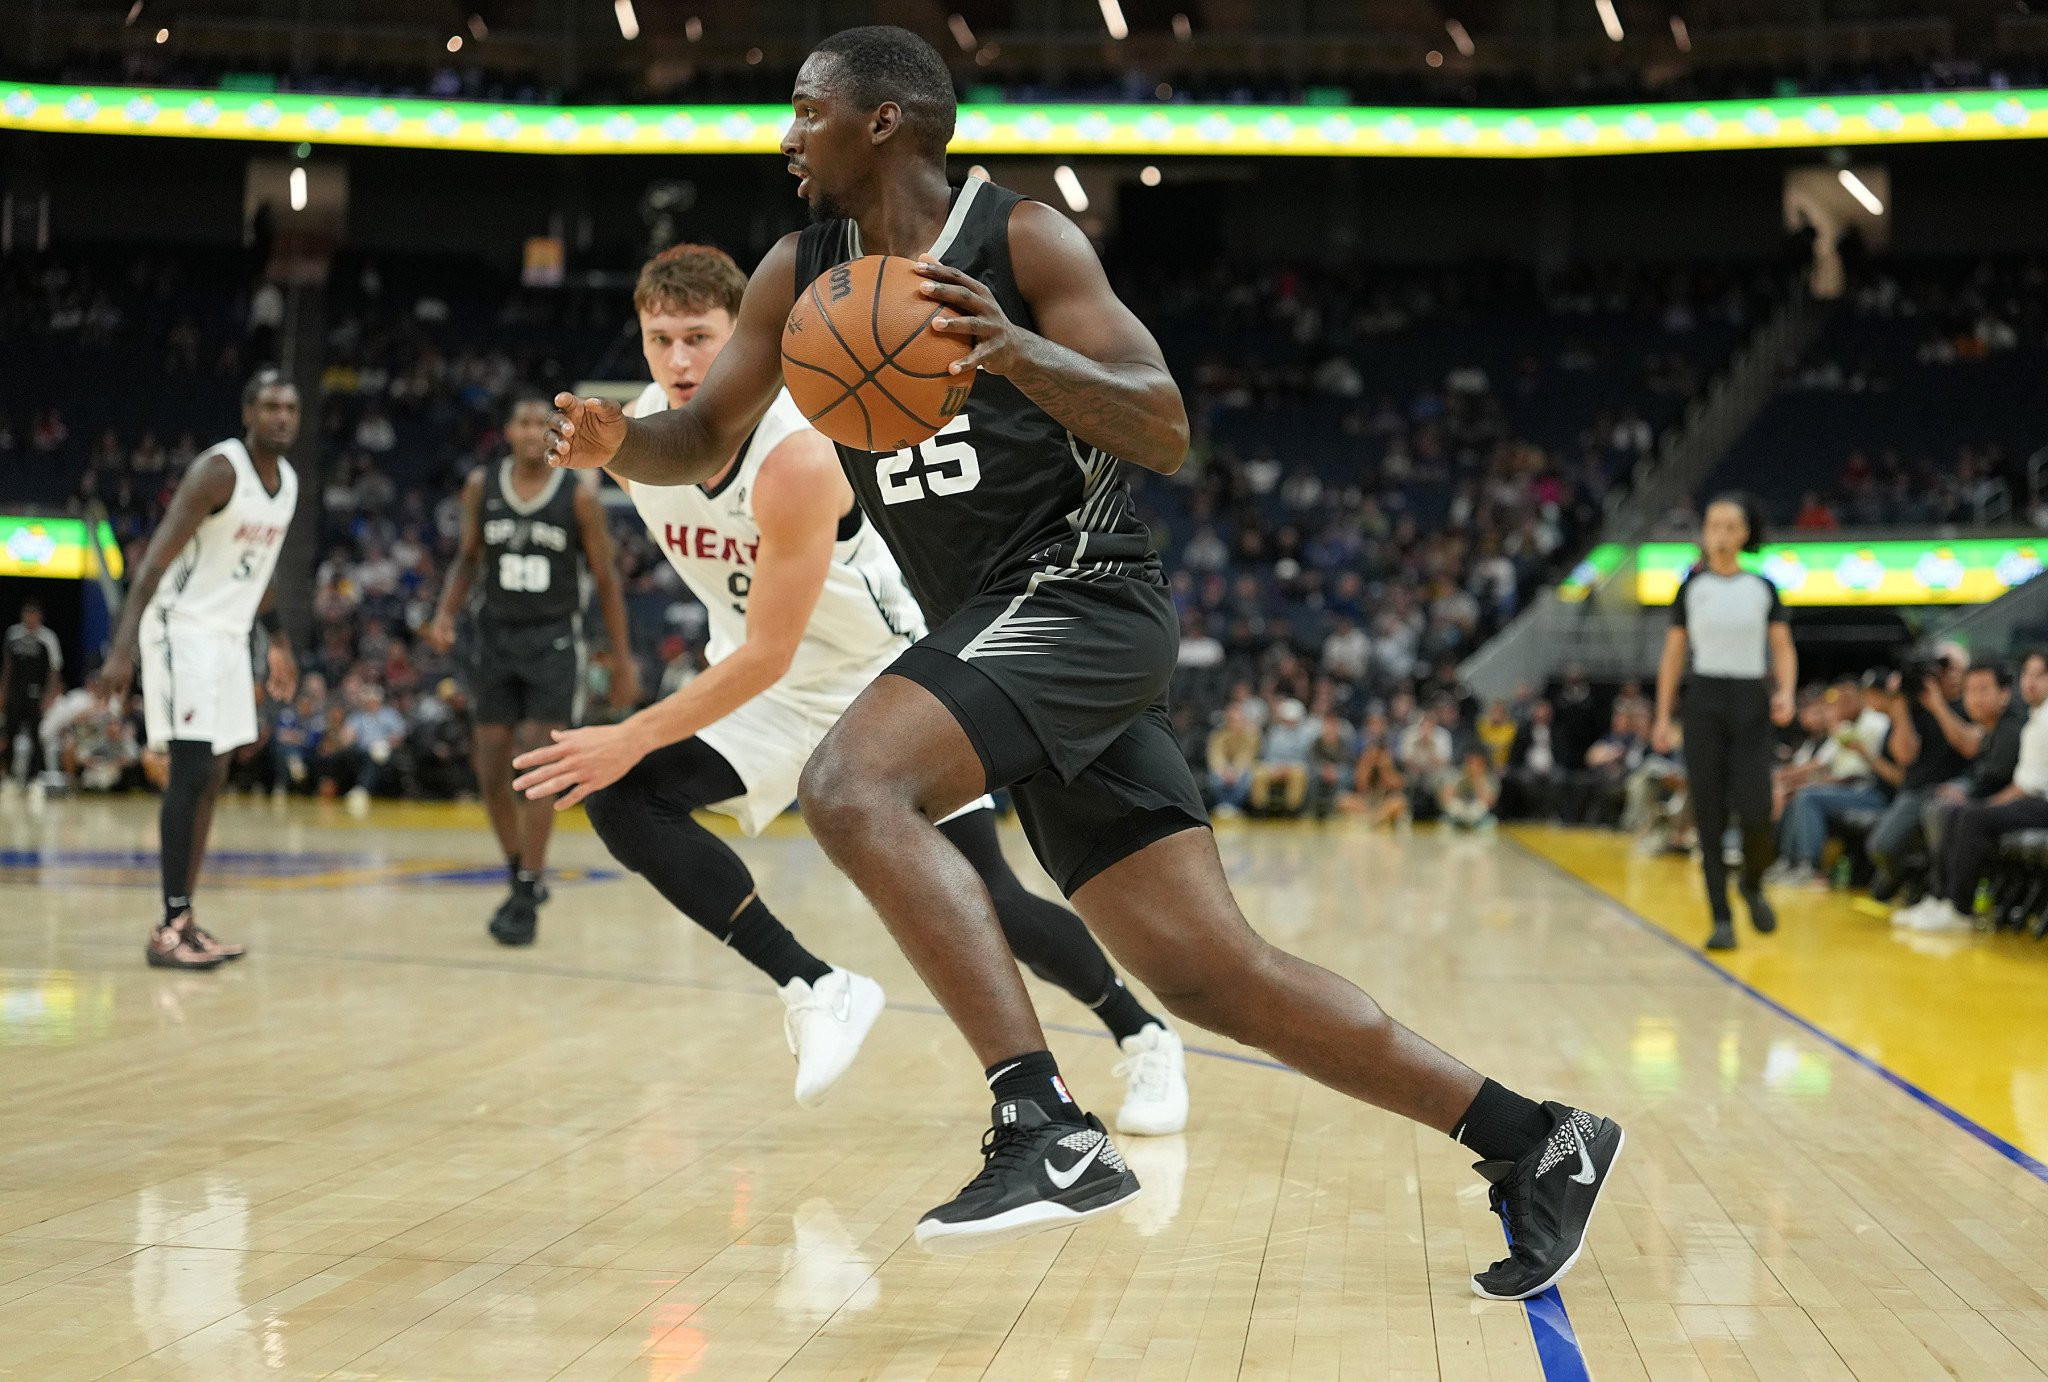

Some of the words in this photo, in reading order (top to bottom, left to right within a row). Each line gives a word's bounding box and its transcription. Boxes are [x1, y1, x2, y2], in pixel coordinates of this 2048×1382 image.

[871, 413, 981, 505] 25
[664, 523, 760, 565] HEAT
[727, 572, 751, 615] 9
